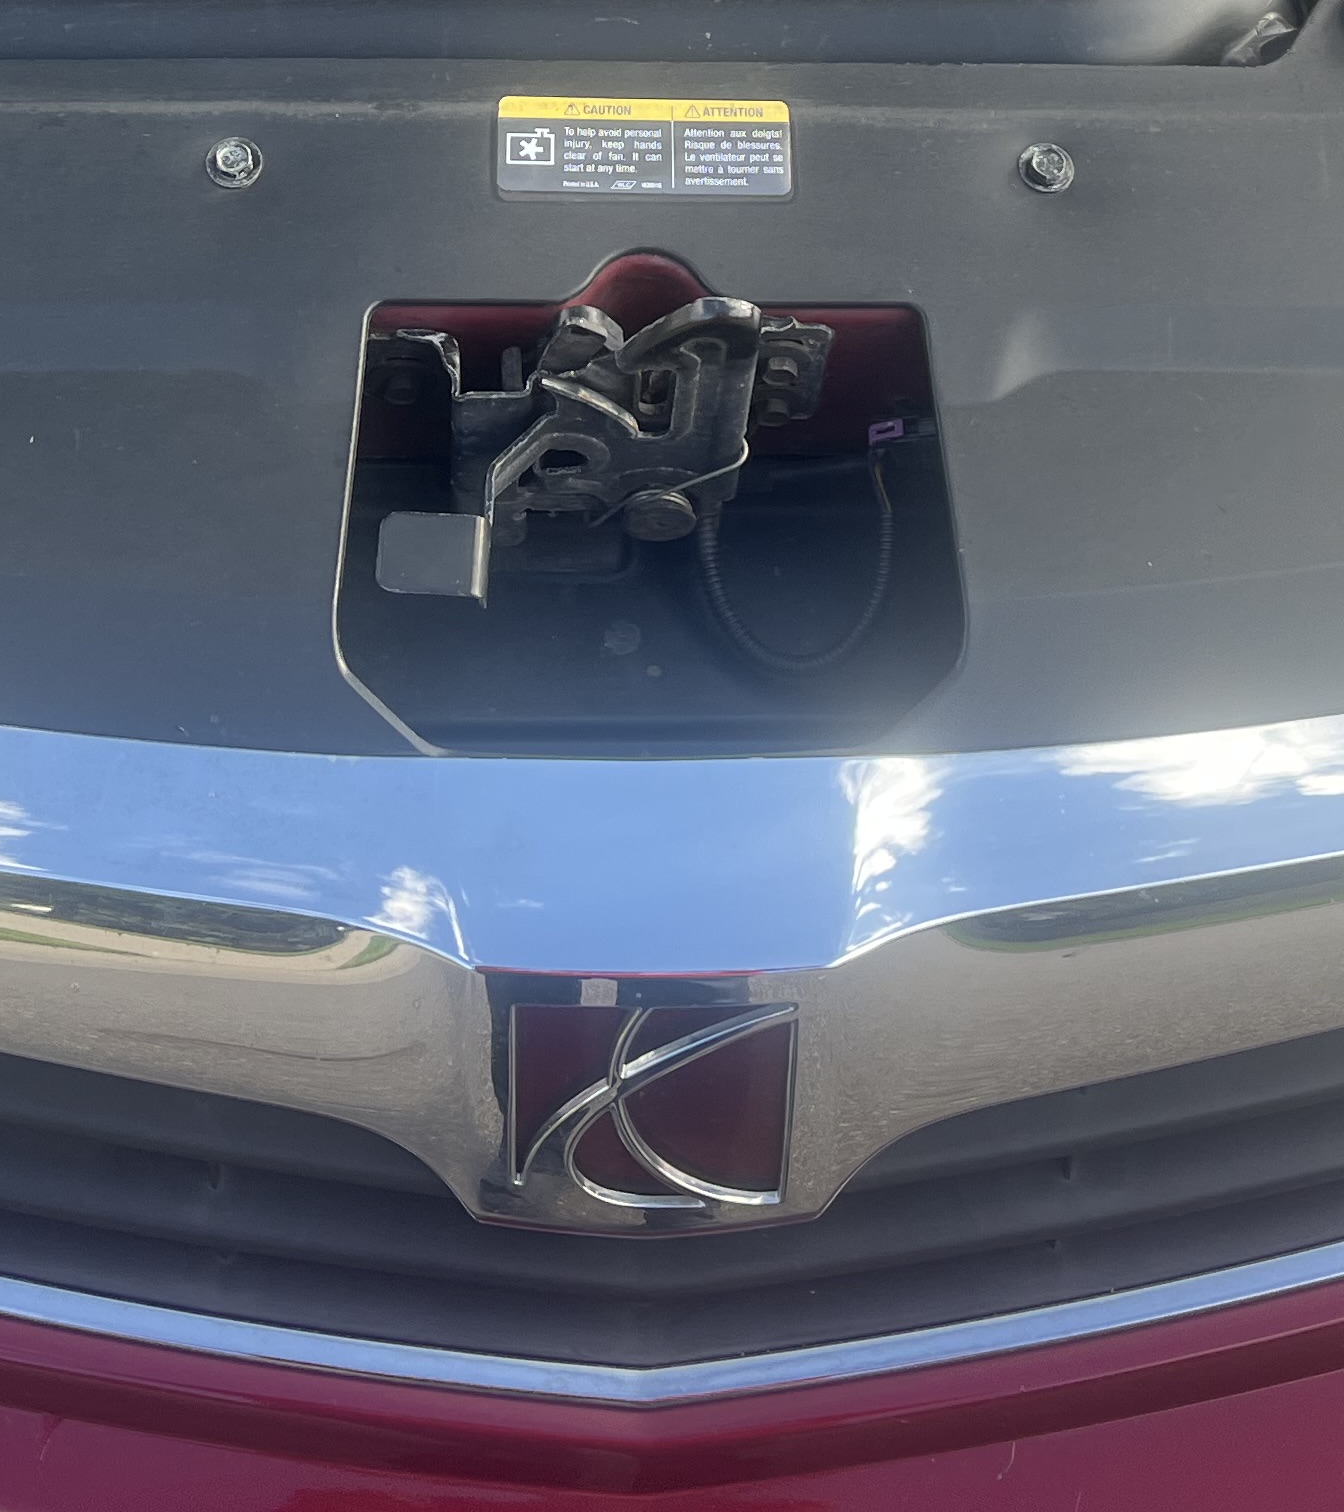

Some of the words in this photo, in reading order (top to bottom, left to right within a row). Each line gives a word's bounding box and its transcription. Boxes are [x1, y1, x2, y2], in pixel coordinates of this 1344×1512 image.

[583, 106, 632, 115] CAUTION
[703, 108, 763, 117] ATTENTION
[564, 127, 574, 135] To
[577, 127, 596, 137] help
[598, 128, 621, 137] avoid
[625, 128, 661, 138] personal
[684, 129, 724, 137] Attention
[602, 140, 624, 150] keep
[634, 140, 661, 149] hands
[685, 141, 715, 150] Risque
[721, 141, 732, 149] de
[737, 141, 783, 150] blessures.
[564, 152, 586, 160] clear
[593, 152, 602, 160] of
[609, 152, 625, 161] fan.
[633, 153, 639, 161] It
[685, 153, 695, 161] Le
[700, 153, 746, 161] ventilateur
[750, 154, 769, 163] peut
[564, 164, 584, 172] start
[586, 164, 595, 172] at
[597, 166, 613, 174] any
[616, 164, 637, 173] time.
[685, 165, 713, 173] mettre
[718, 165, 723, 173] à
[728, 166, 759, 174] tourner
[685, 177, 749, 186] avertissement.
